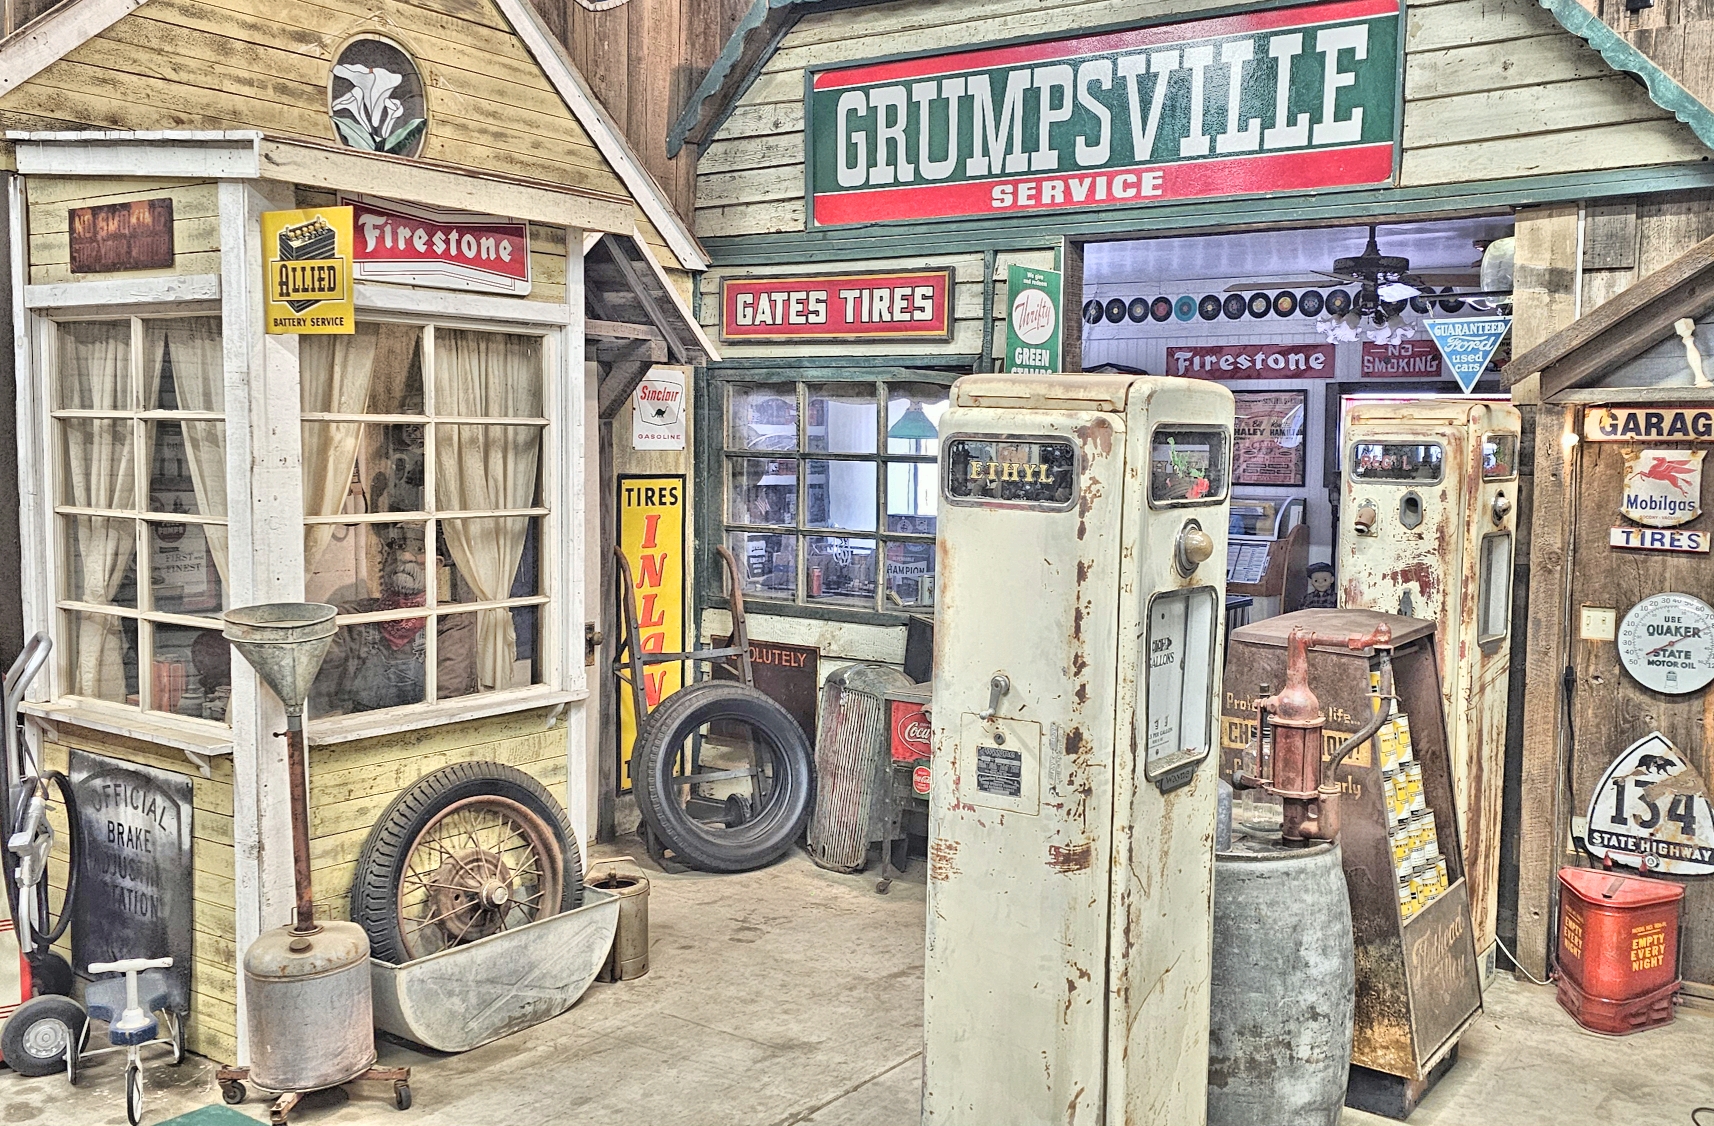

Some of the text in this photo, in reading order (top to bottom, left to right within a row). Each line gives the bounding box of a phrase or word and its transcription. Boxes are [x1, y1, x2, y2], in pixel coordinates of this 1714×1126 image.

[836, 24, 1368, 188] GRUMPSVILLE
[991, 171, 1164, 208] SERVICE
[74, 213, 94, 238] NO
[358, 213, 513, 263] Firestone
[278, 263, 337, 298] ALLIED
[735, 285, 934, 326] GATES TIRES
[1015, 294, 1051, 330] Thrifty
[273, 316, 345, 328] BATTERY SERVICE
[1434, 322, 1505, 337] GUARANTEED
[1388, 344, 1412, 356] NO
[1444, 335, 1495, 352] Ford
[1015, 347, 1050, 367] GREEN
[1174, 351, 1326, 376] Firestone
[1364, 355, 1438, 373] SMOKING
[1452, 352, 1483, 363] used
[1455, 362, 1480, 372] cars
[640, 385, 679, 402] Sinclair
[970, 460, 1055, 485] ETHYL
[624, 486, 679, 508] TIRES
[1626, 494, 1696, 515] Mobilgas
[1621, 530, 1701, 550] TIRES
[165, 552, 194, 562] FIRST
[166, 563, 202, 573] FINEST
[1664, 615, 1683, 624] USE
[1646, 624, 1702, 639] QUAKER
[1647, 659, 1696, 670] MOTOR OIL
[1653, 649, 1692, 660] STATE
[92, 784, 167, 832] OFFICIAL
[1610, 779, 1696, 837] 134
[107, 820, 152, 853] BRAKE
[1592, 832, 1712, 862] STATE HIGHWAY
[109, 883, 160, 921] TATION
[1565, 916, 1583, 938] EMPTY
[1564, 925, 1583, 950] EVERY
[1632, 933, 1665, 950] EMPTY
[1631, 944, 1666, 961] EVERY
[1632, 955, 1664, 972] NIGHT
